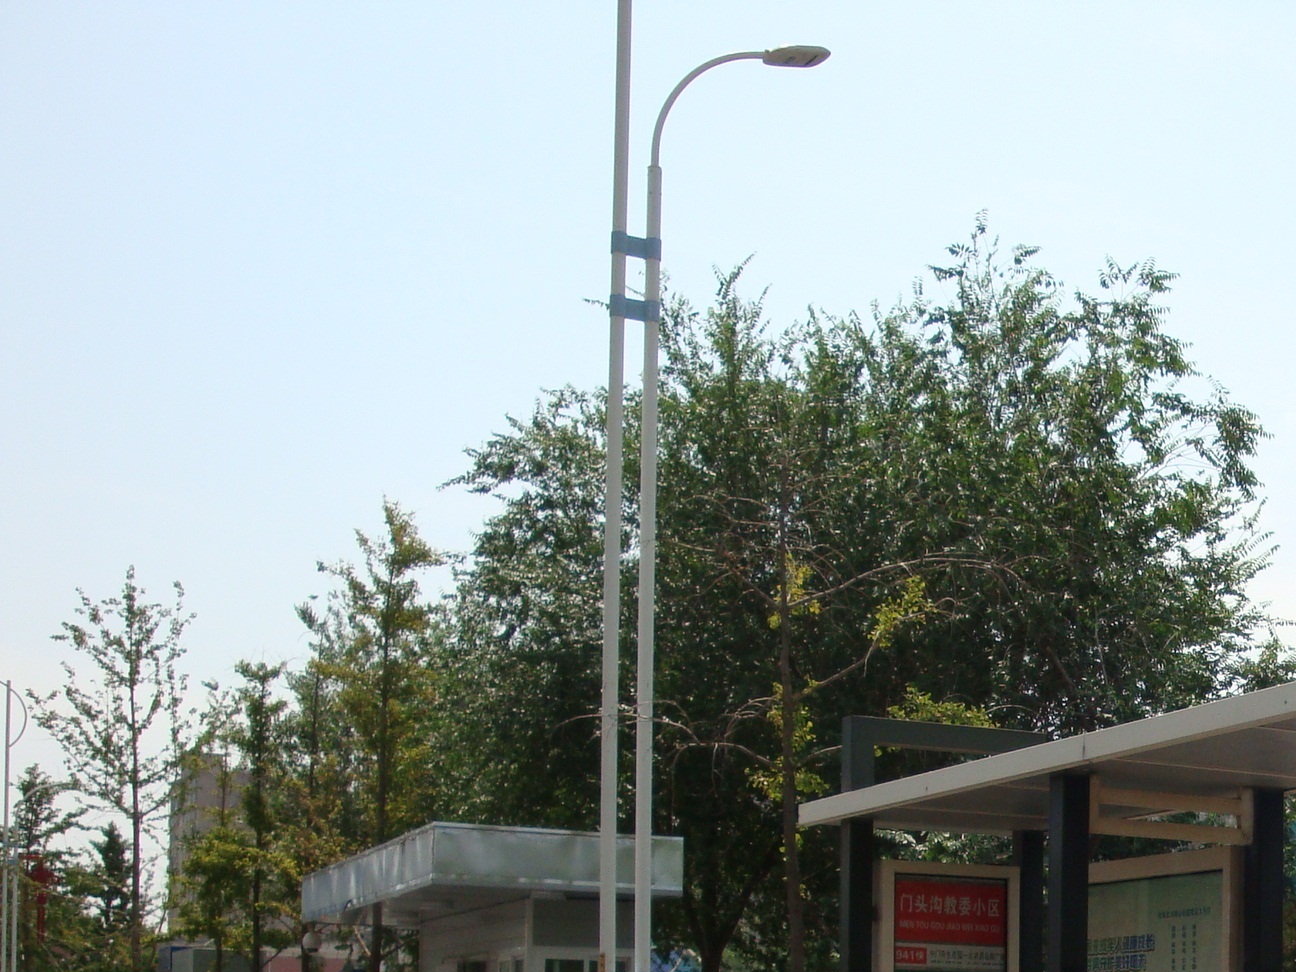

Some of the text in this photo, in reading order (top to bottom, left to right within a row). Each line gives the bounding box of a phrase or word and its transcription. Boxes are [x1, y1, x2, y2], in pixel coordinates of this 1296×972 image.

[900, 893, 1000, 918] 门头沟教委小区
[896, 949, 924, 962] 941快
